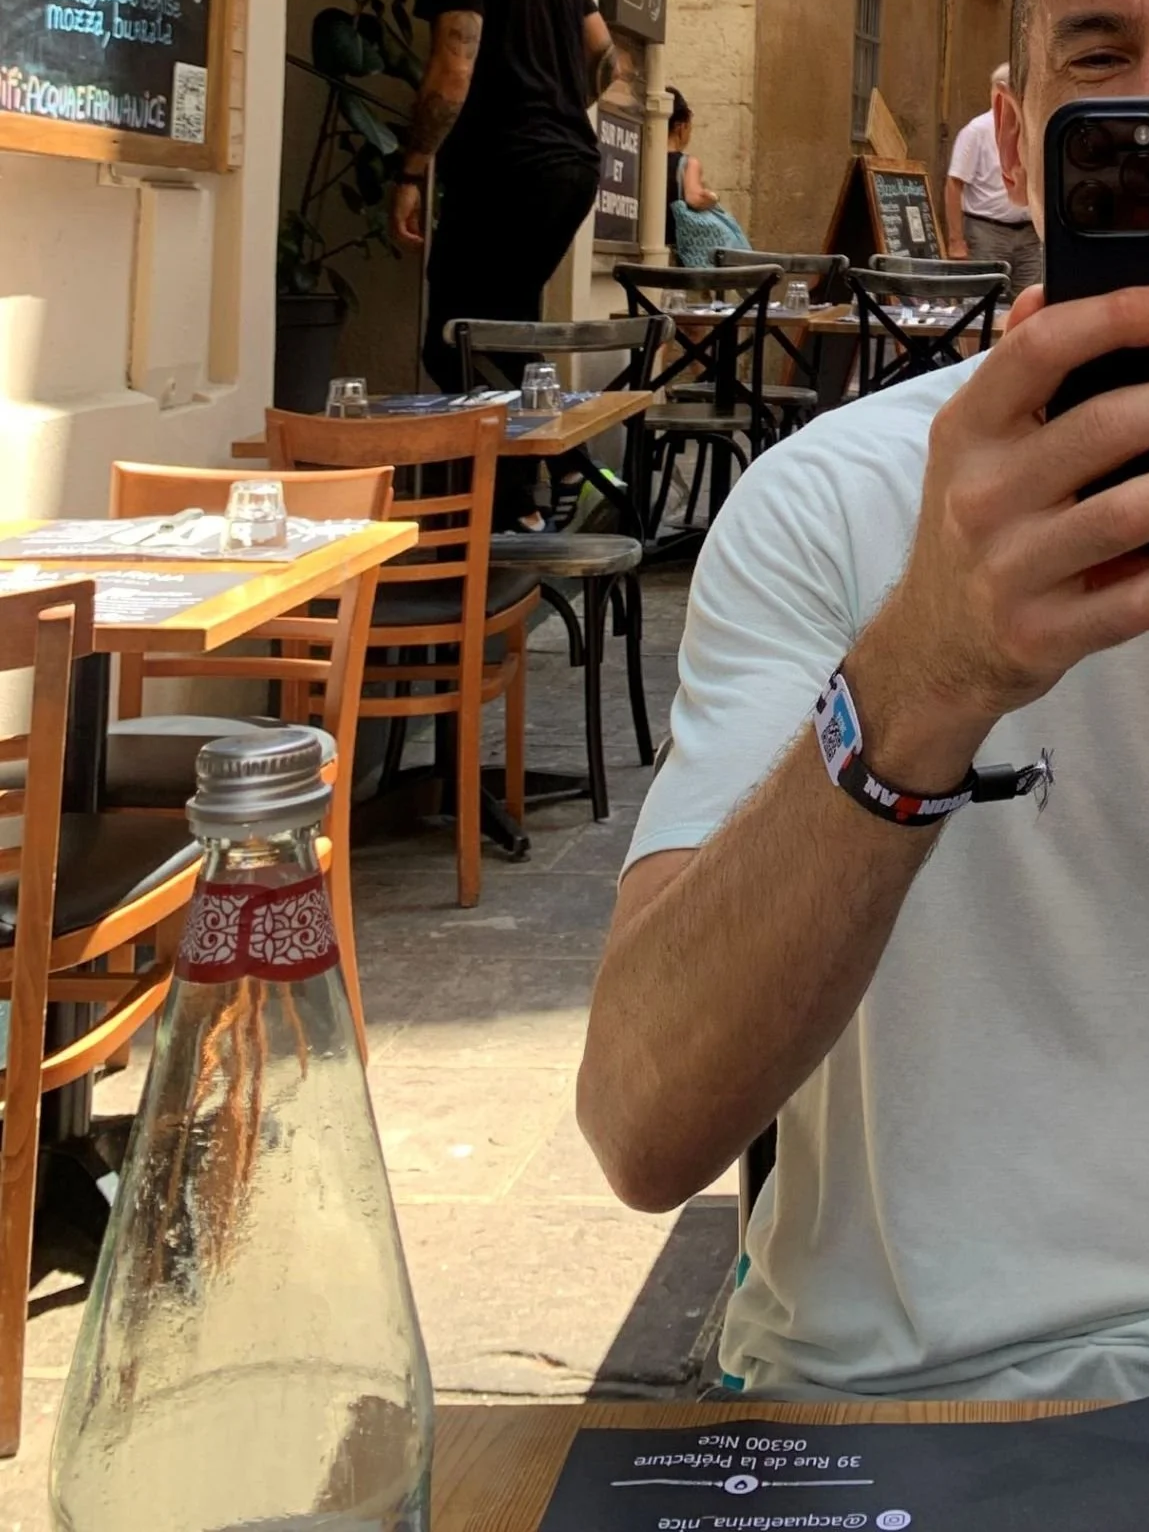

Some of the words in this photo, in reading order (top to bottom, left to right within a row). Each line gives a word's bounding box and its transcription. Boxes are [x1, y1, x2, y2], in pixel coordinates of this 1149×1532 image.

[613, 158, 624, 183] ET
[601, 189, 638, 220] EMPORTER
[698, 1434, 740, 1451] Nice
[745, 1438, 807, 1452] 06300
[634, 1453, 734, 1469] Préfecture
[741, 1456, 757, 1470] la
[764, 1456, 787, 1470] de
[794, 1455, 830, 1469] Rue
[836, 1454, 864, 1469] 39
[657, 1513, 868, 1532] @acquaefarina_nice
